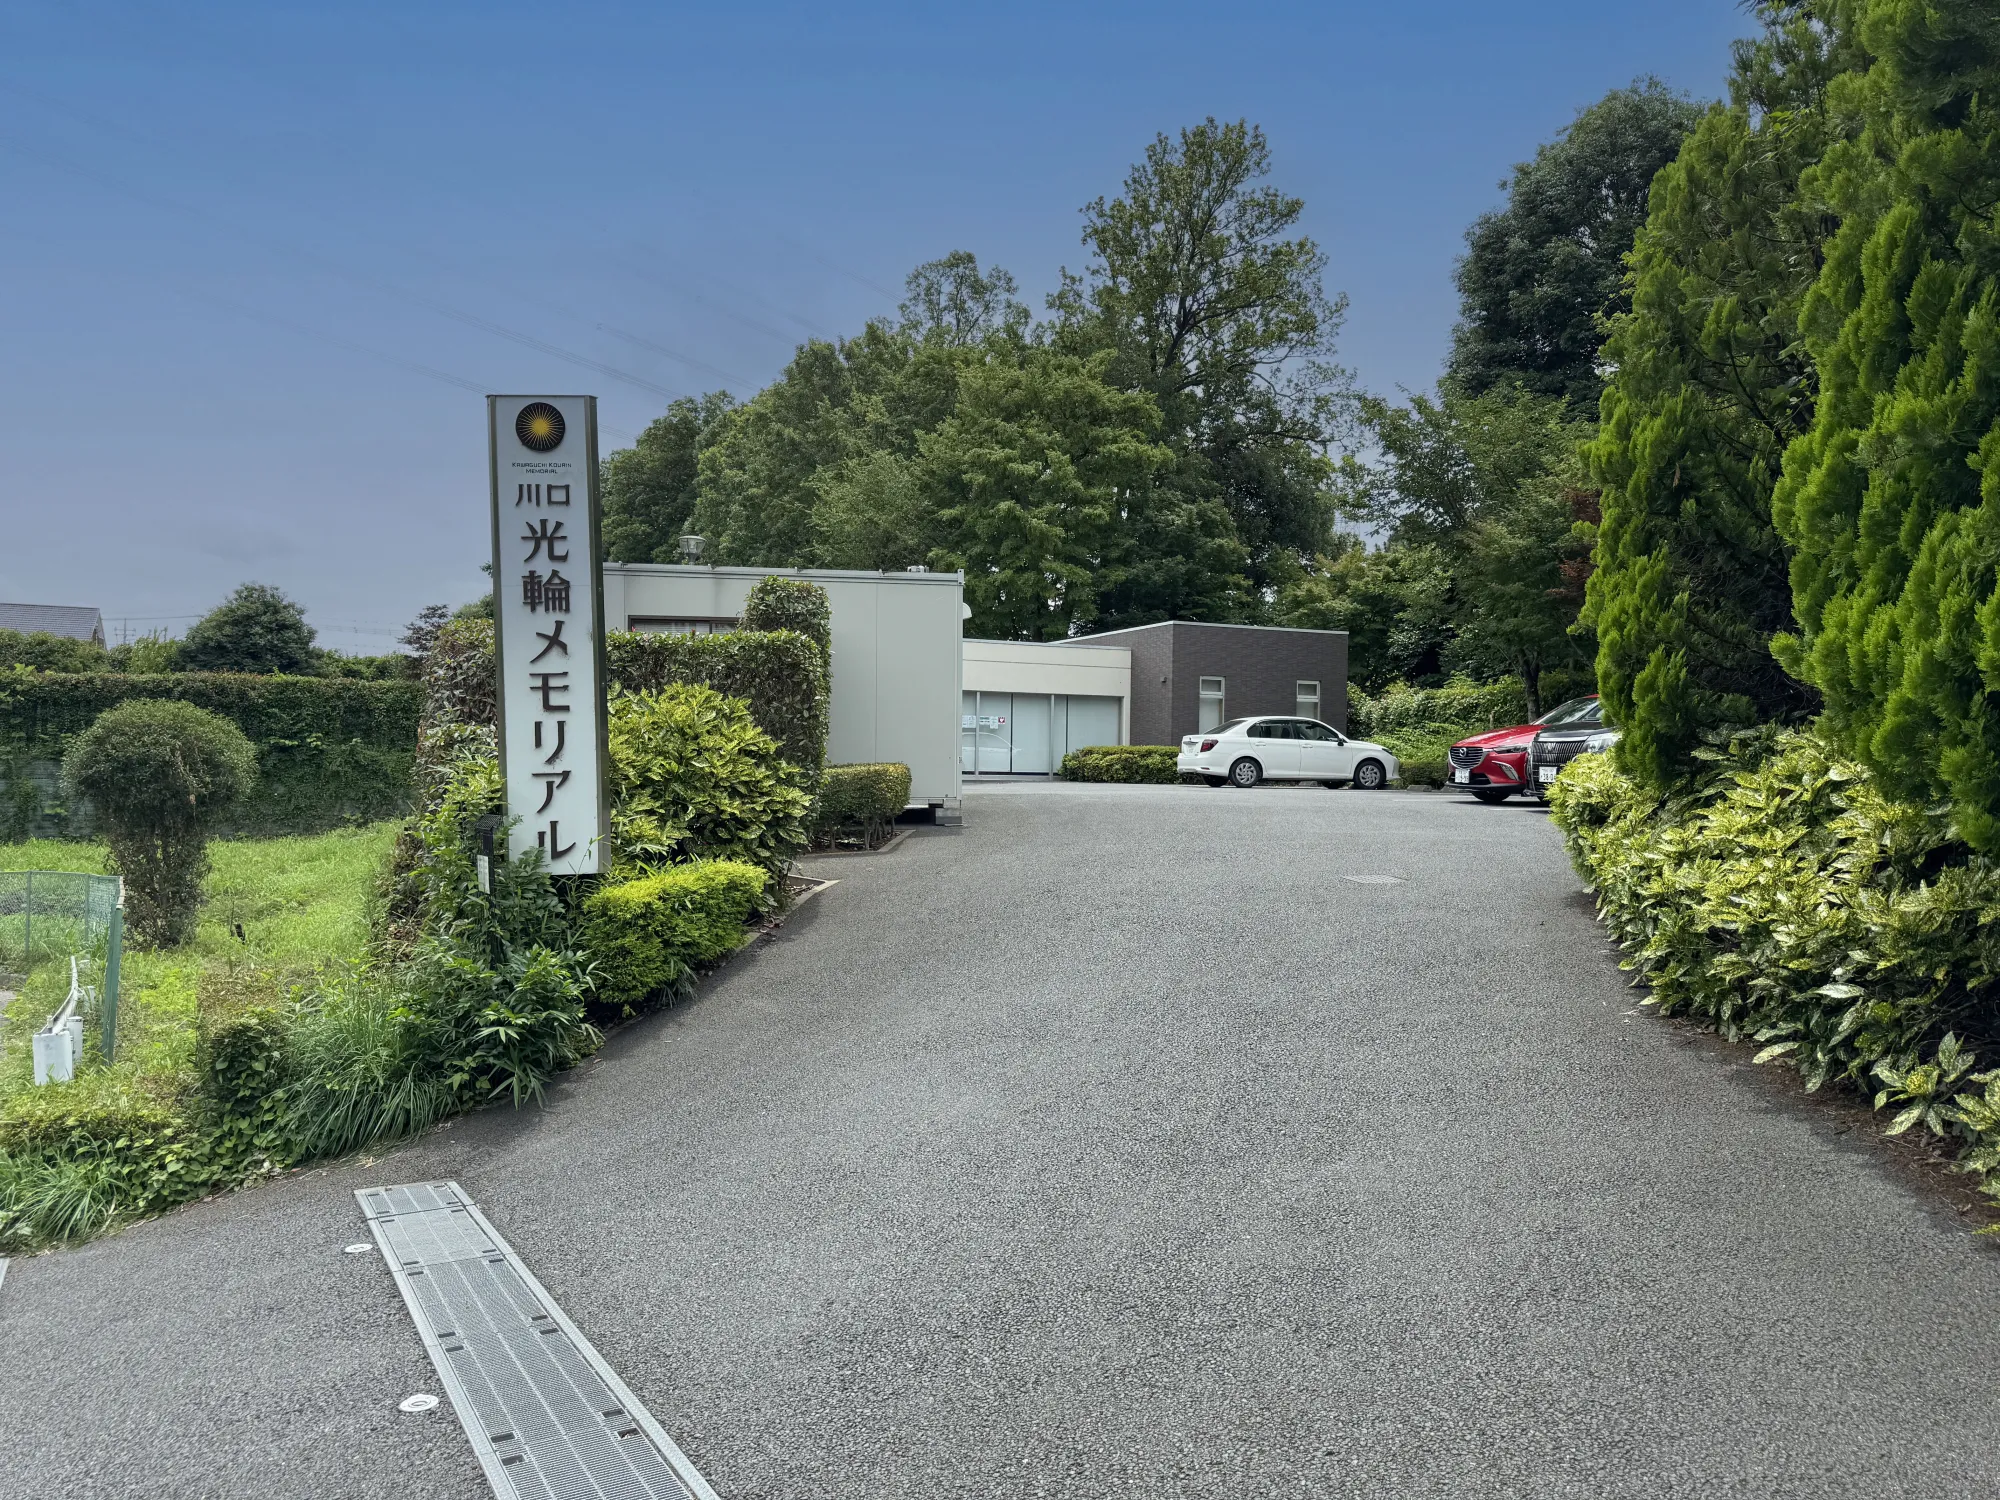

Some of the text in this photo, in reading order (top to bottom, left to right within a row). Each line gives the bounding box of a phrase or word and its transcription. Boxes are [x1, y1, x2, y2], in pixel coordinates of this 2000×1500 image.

[515, 483, 571, 508] 川口
[520, 518, 577, 860] 光輪メモリアル
